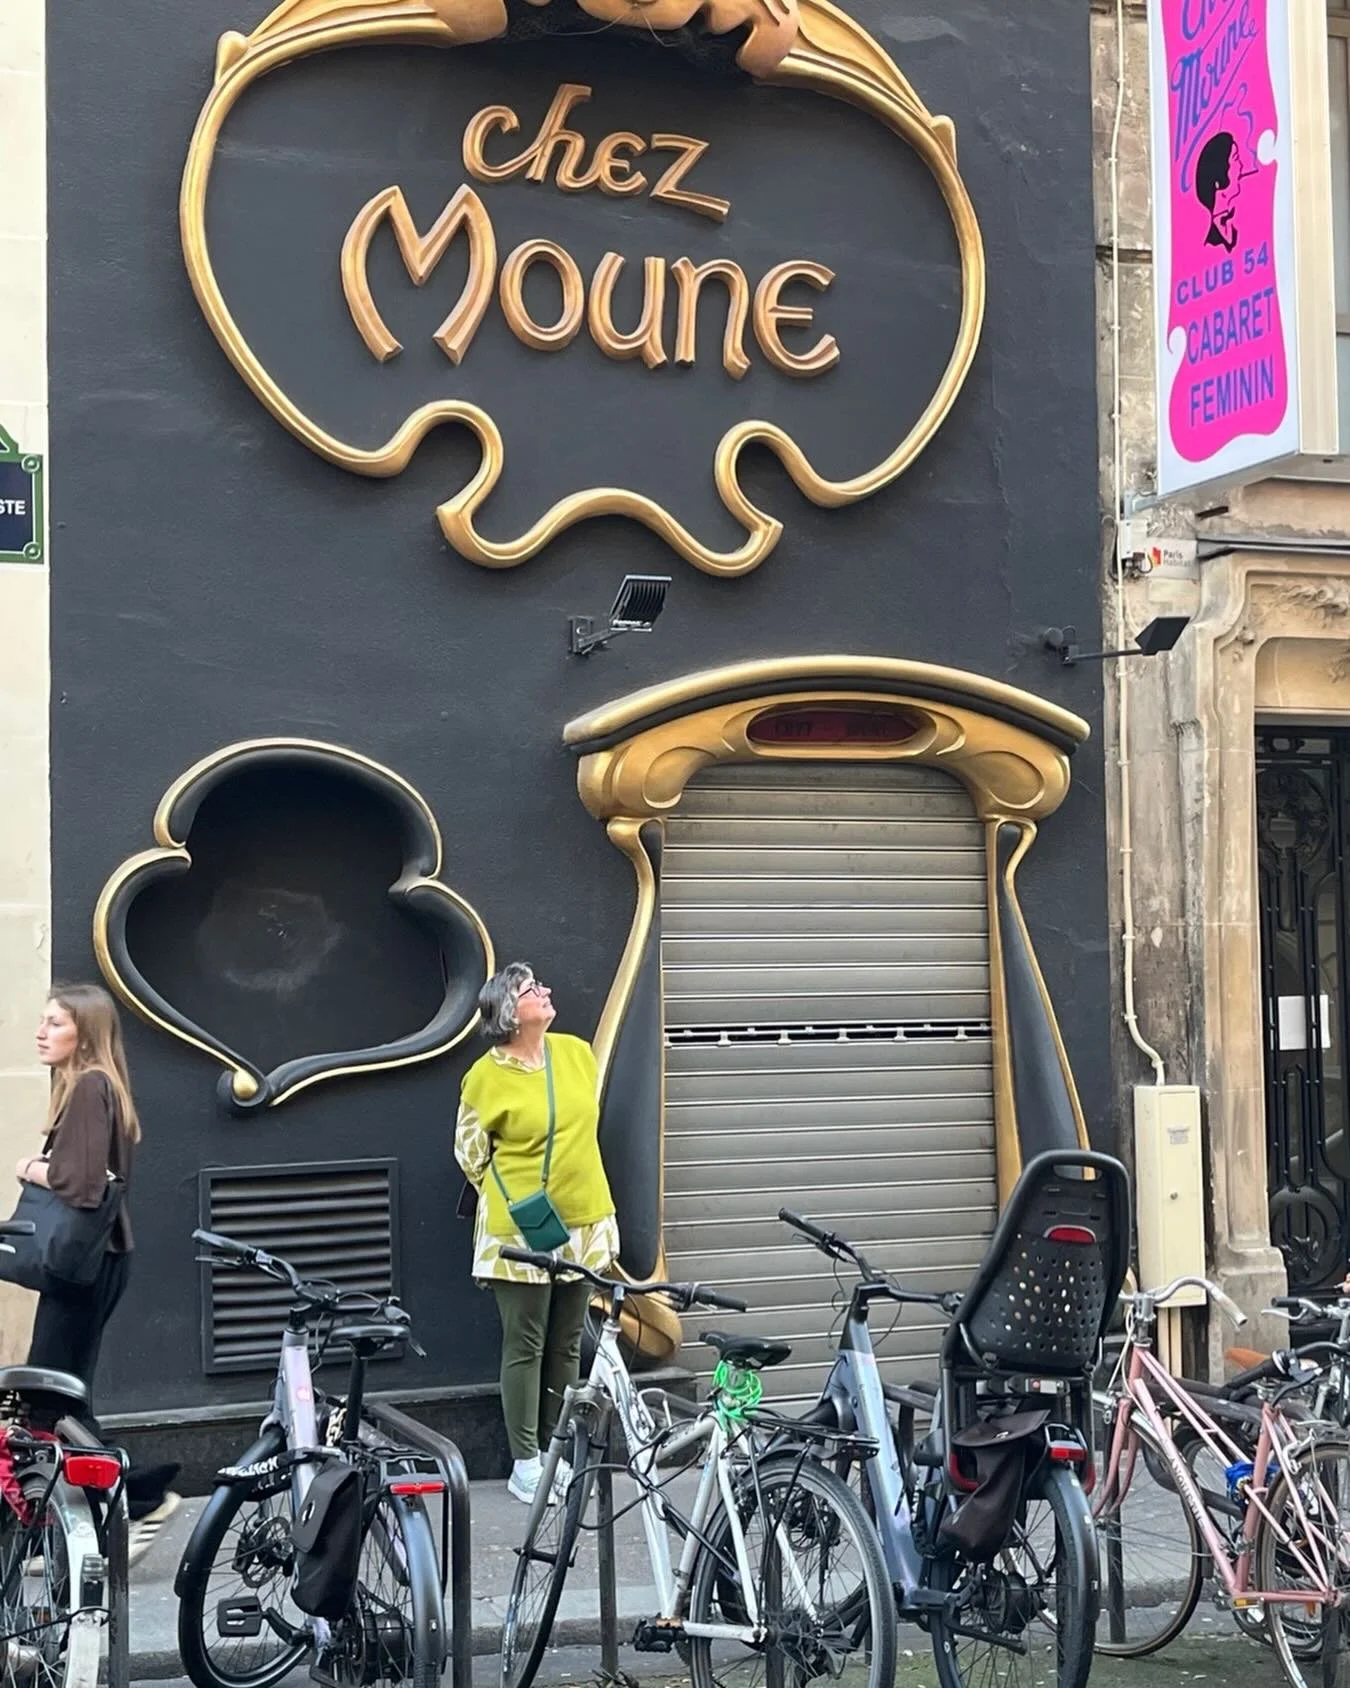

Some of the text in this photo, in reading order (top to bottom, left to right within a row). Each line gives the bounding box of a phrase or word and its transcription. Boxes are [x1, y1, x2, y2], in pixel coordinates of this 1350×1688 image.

[1176, 241, 1269, 305] CLUB 54
[1186, 287, 1274, 365] CABARET
[1190, 355, 1274, 428] FEMININ
